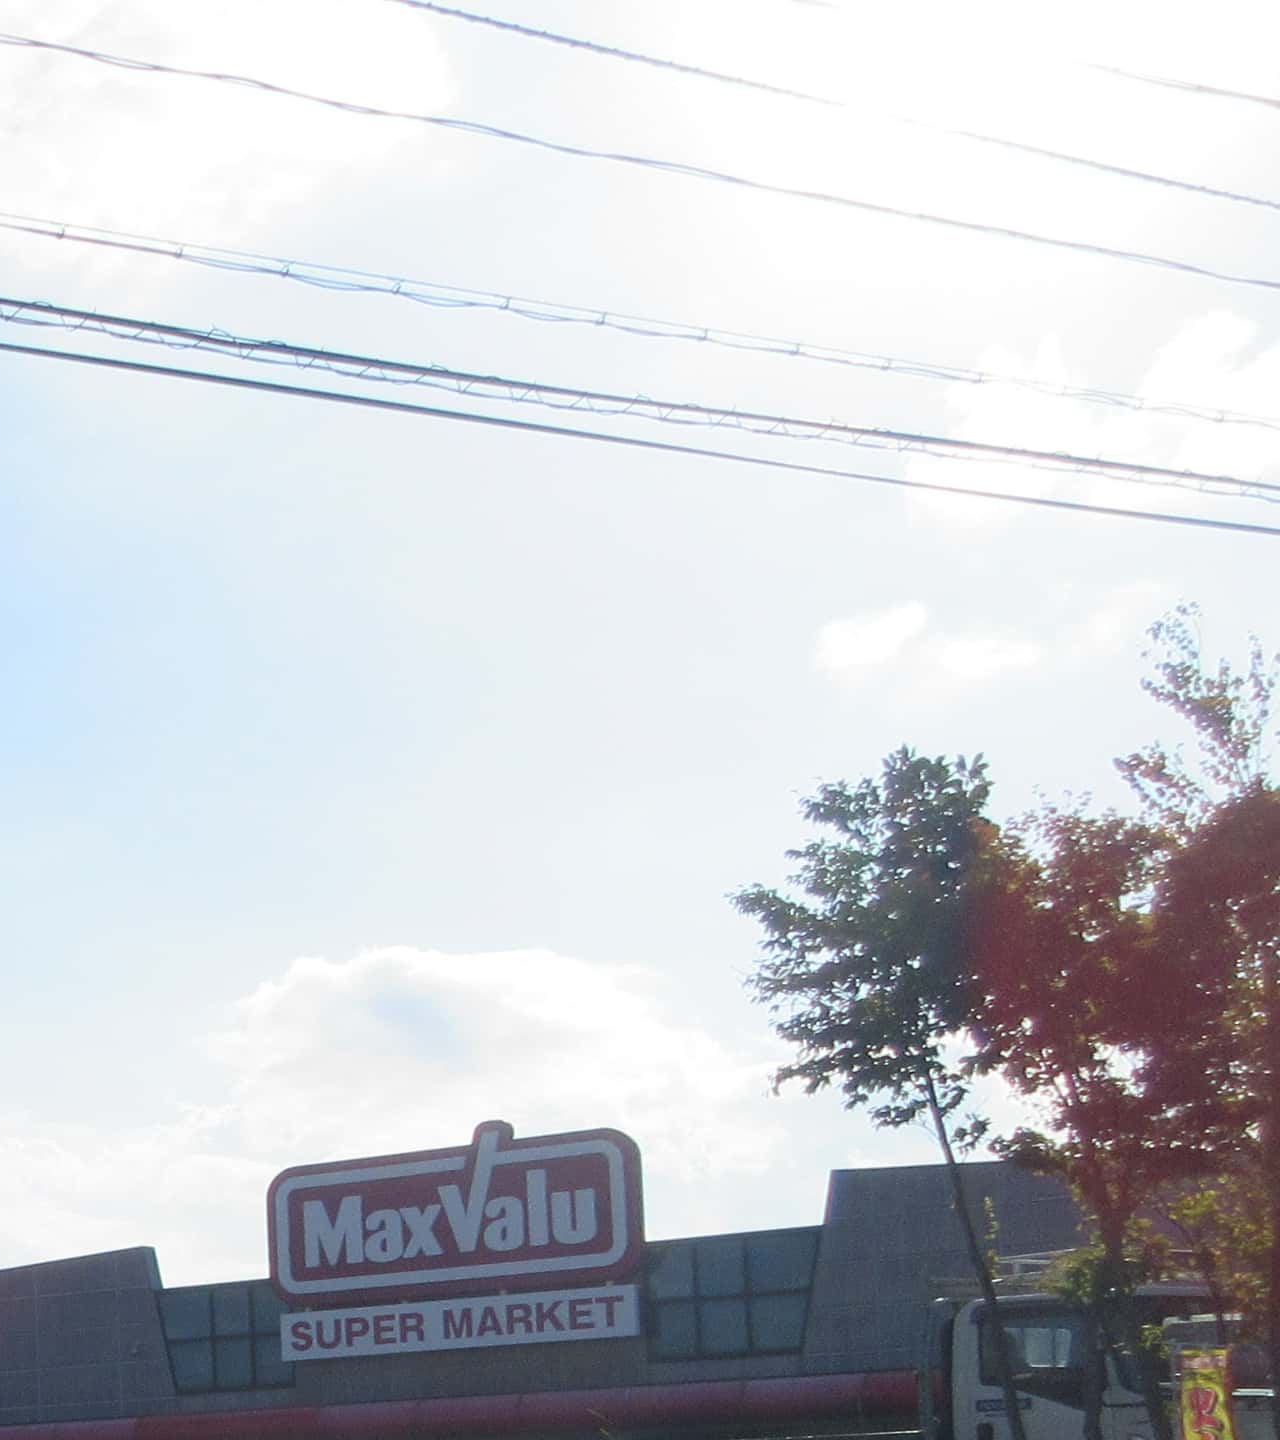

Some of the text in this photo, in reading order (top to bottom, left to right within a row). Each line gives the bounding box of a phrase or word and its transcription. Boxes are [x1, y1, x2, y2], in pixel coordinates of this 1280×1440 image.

[303, 1131, 598, 1269] MaxValu
[290, 1295, 624, 1351] SUPER MARKET
